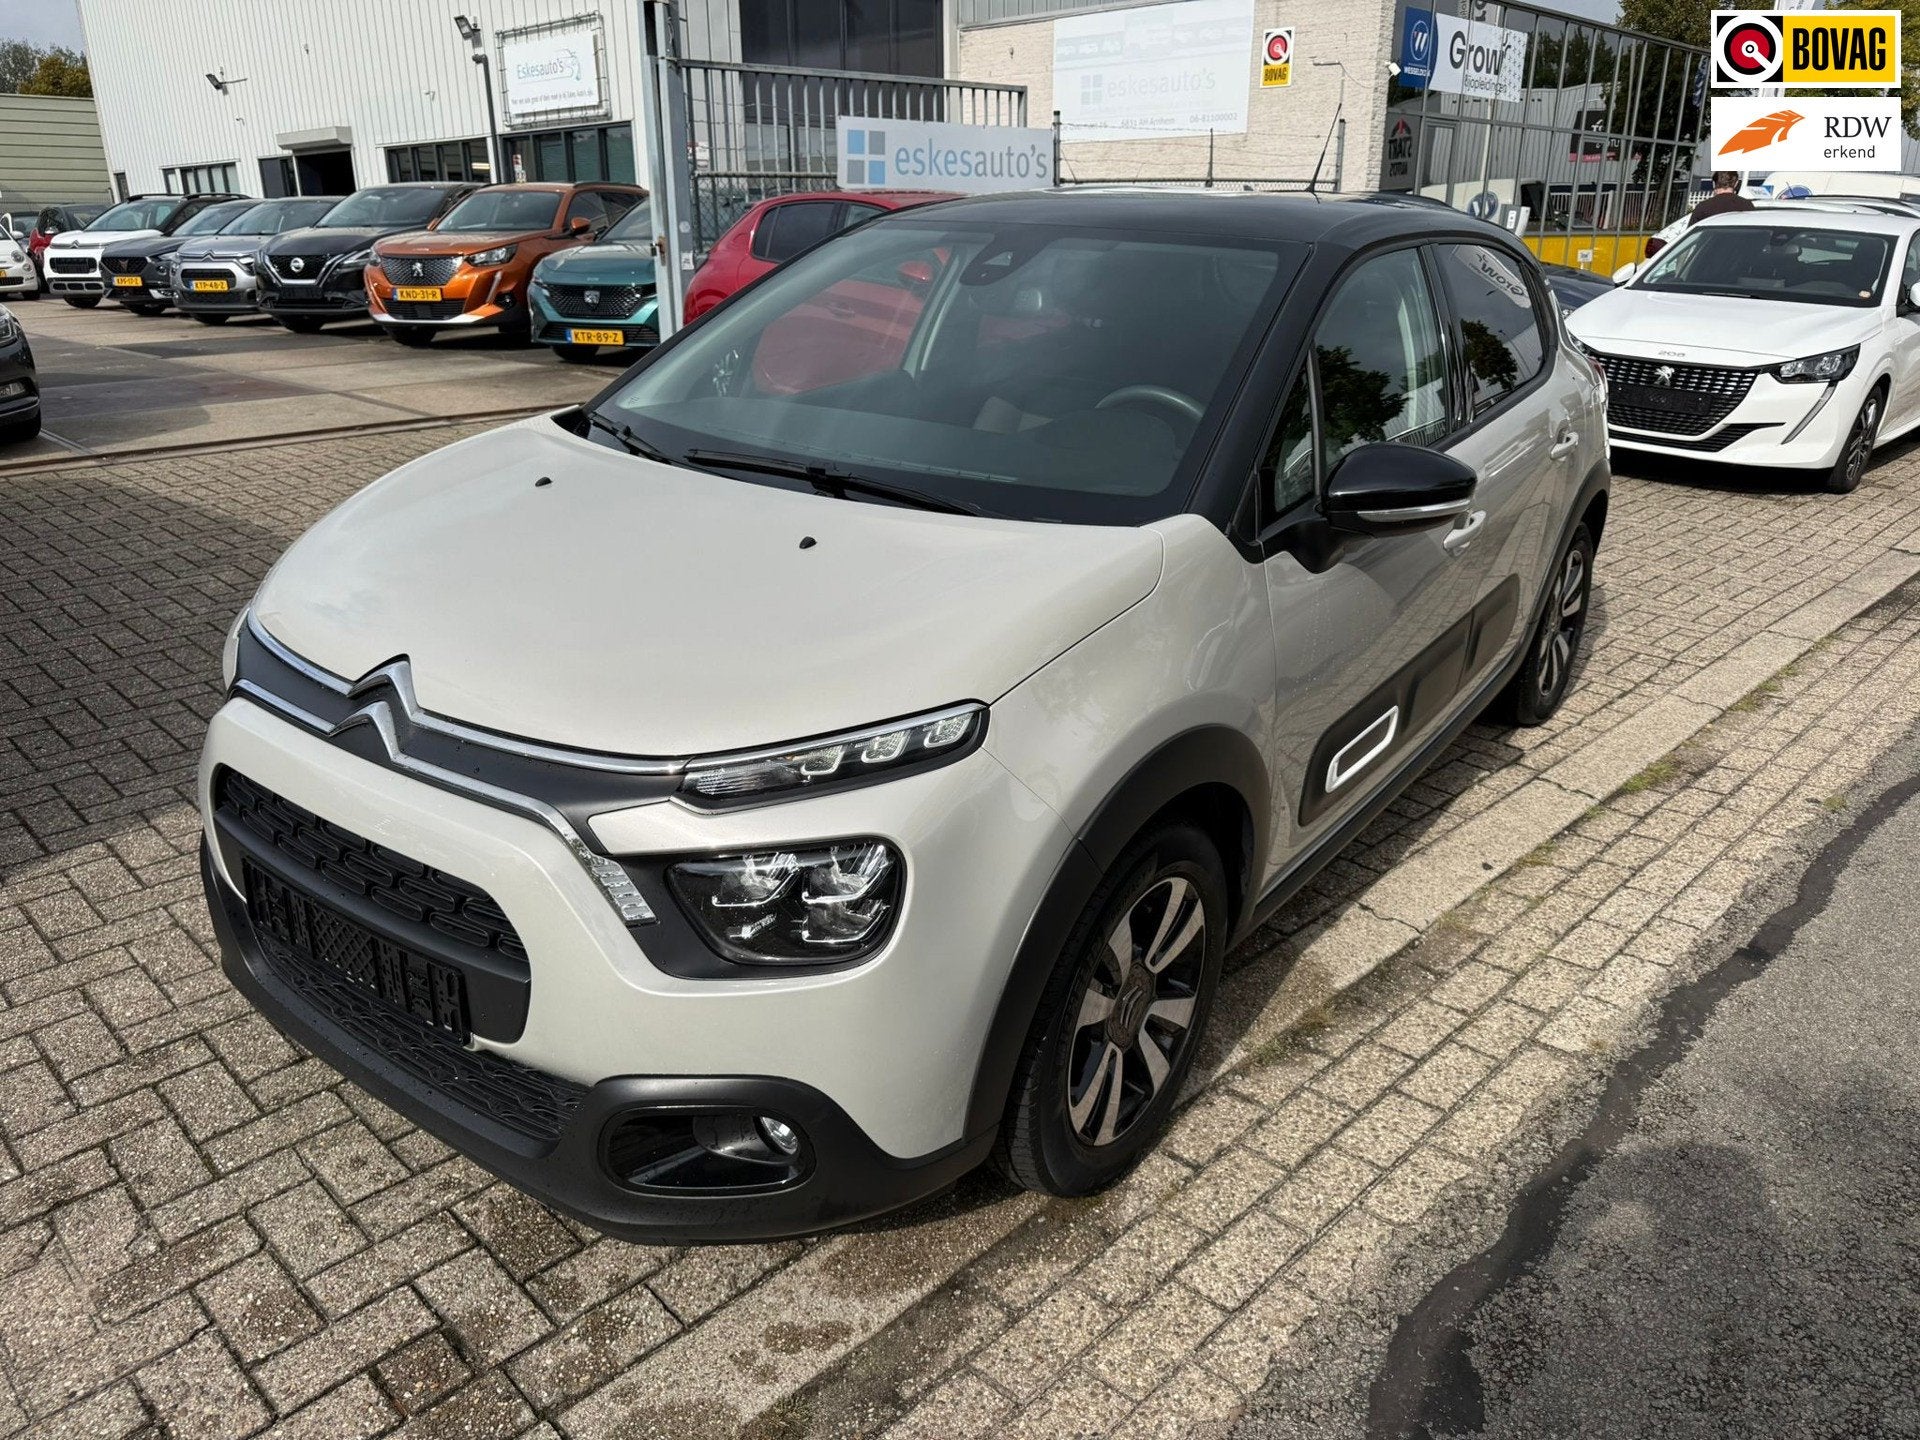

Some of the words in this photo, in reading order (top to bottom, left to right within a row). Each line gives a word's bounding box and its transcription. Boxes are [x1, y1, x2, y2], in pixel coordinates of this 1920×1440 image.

[517, 58, 564, 79] Eskesauto's
[1264, 67, 1288, 82] BOVAG
[1108, 67, 1216, 98] eskesauto's
[894, 138, 1048, 179] eskesauto's
[400, 289, 438, 300] KND-31-R
[574, 331, 618, 343] KTR-89-Z
